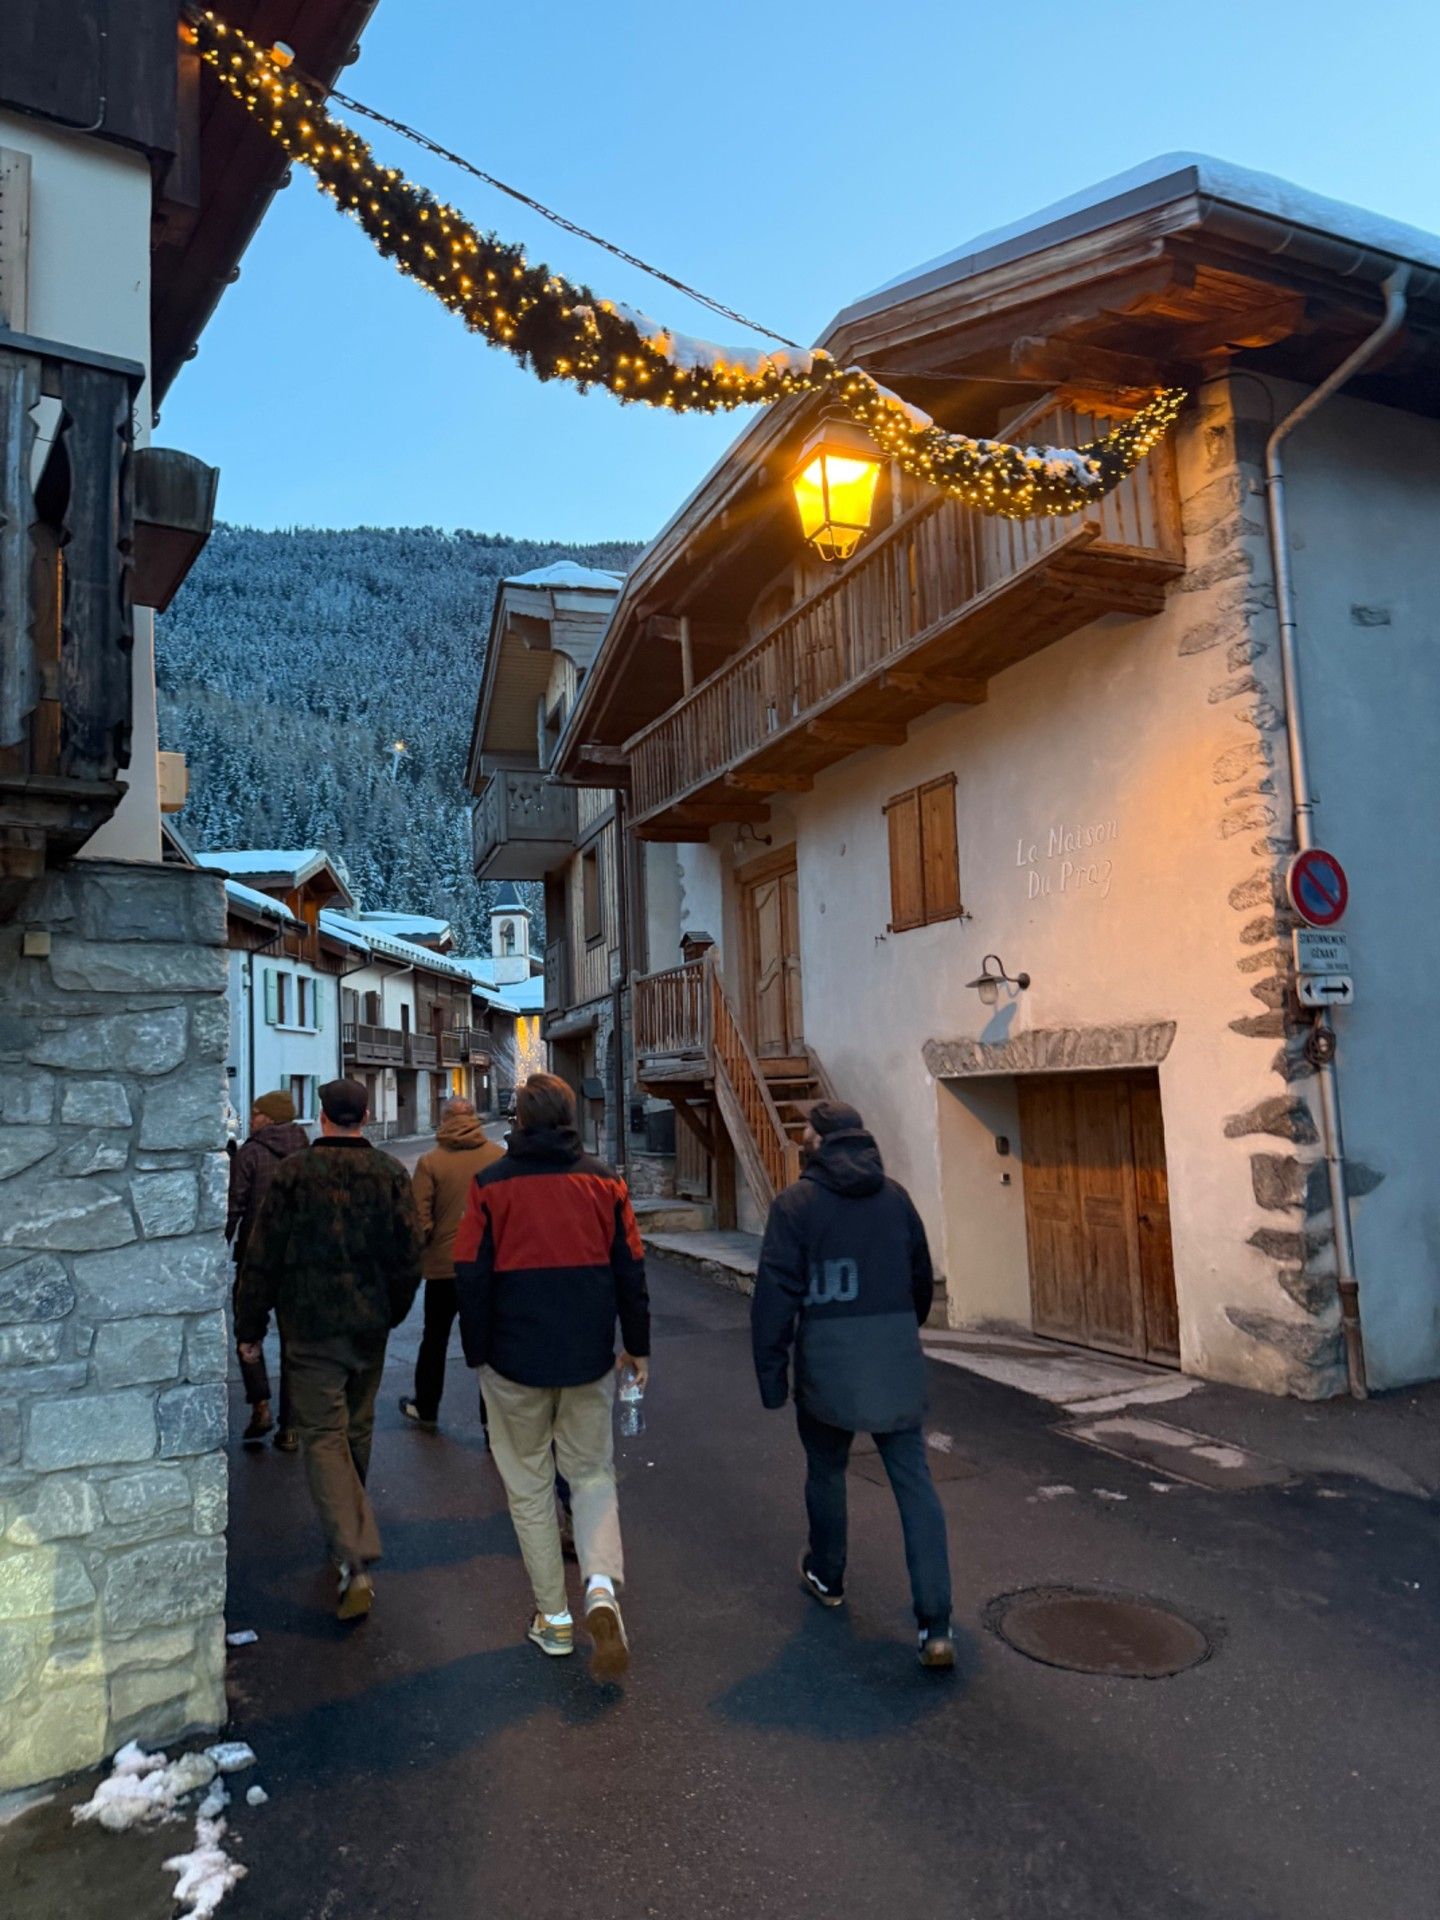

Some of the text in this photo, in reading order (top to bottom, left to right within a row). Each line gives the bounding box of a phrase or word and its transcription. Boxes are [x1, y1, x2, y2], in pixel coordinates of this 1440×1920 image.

[1016, 819, 1119, 867] La Maison
[1028, 870, 1051, 899] Du
